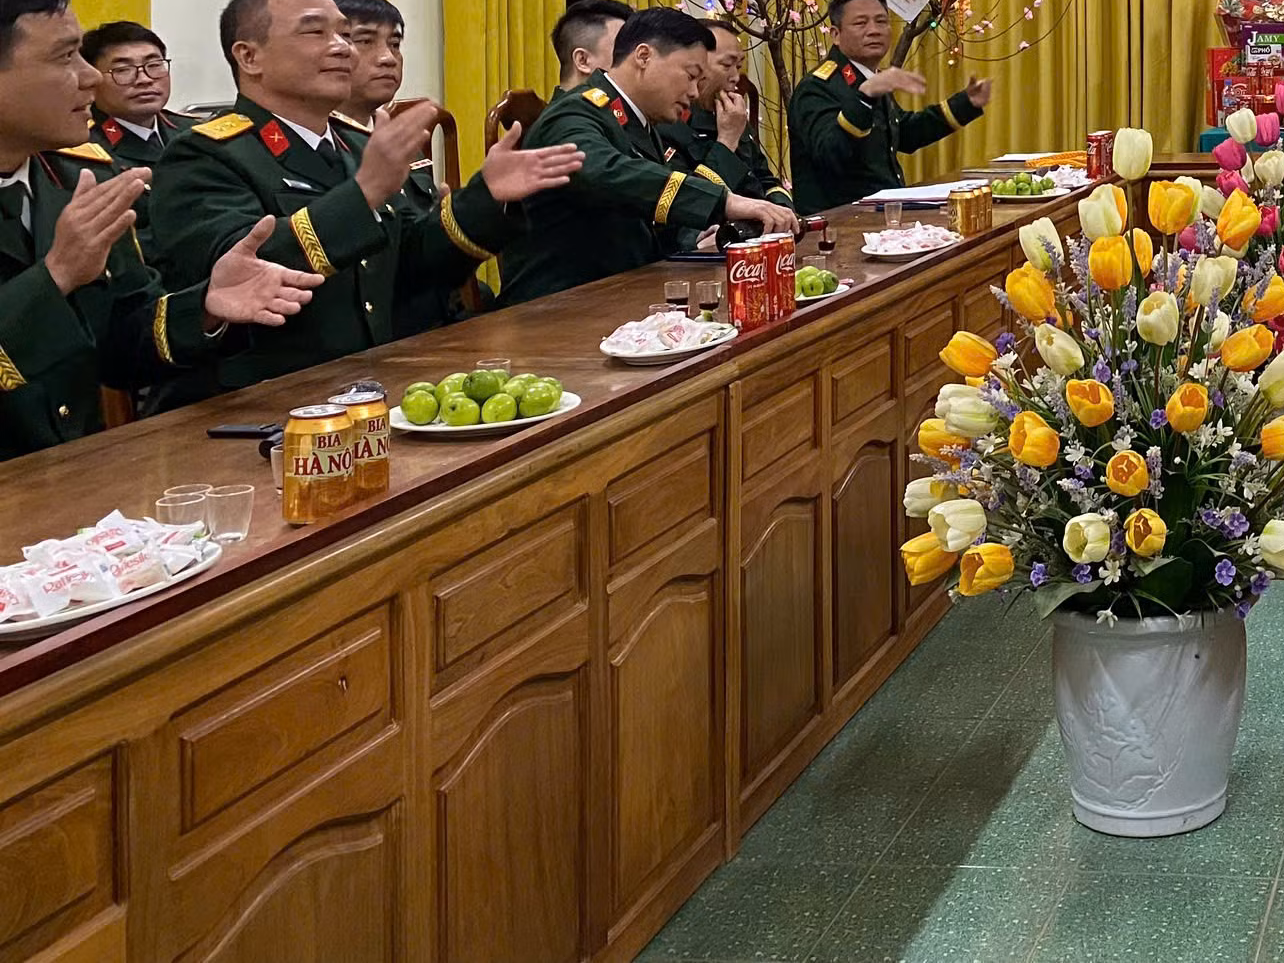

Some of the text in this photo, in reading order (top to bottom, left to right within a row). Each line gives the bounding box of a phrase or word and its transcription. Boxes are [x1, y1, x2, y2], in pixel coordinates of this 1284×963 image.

[1247, 31, 1281, 46] JAMY
[368, 417, 387, 433] BIA
[317, 433, 342, 449] BIA
[293, 447, 353, 476] HÀ NỘ
